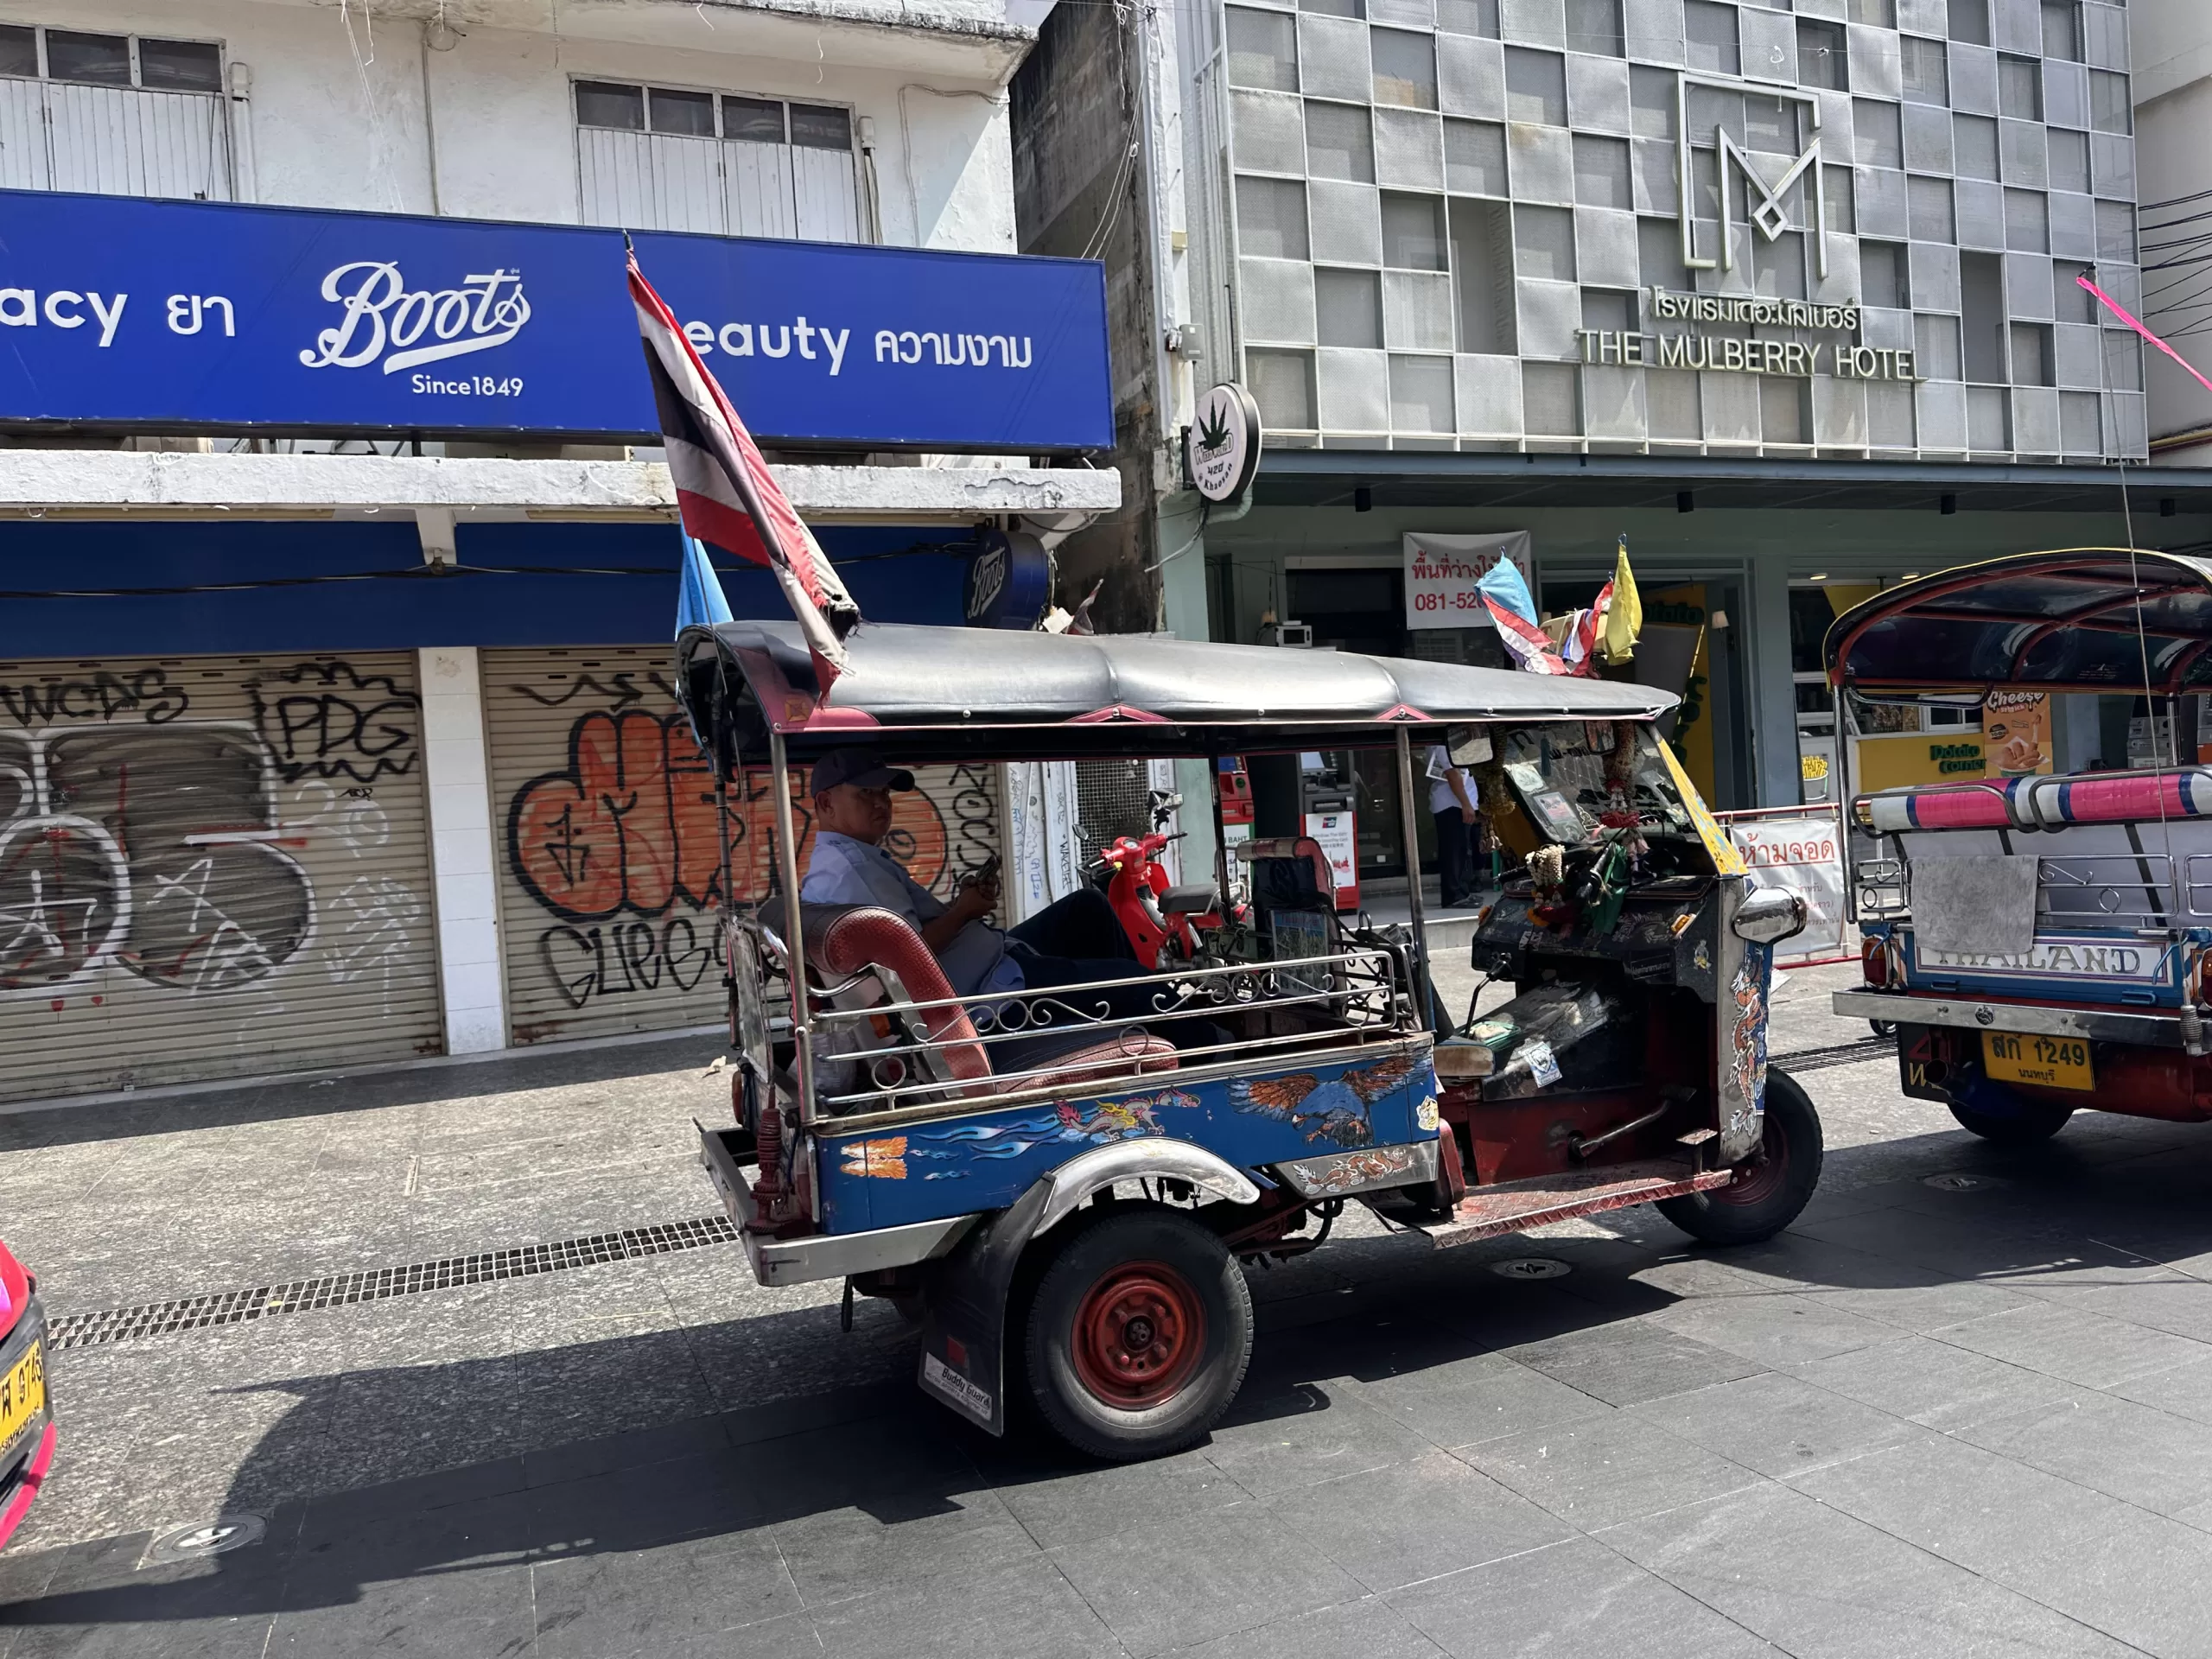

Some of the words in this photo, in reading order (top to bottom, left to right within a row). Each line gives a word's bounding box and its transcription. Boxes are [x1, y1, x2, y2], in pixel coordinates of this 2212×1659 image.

[167, 295, 236, 338] ยา
[299, 261, 532, 374] Boots
[679, 315, 850, 377] eauty
[874, 328, 1033, 369] ความงาม
[1574, 328, 1644, 366] THE
[1658, 334, 1823, 375] MULBERRY
[1831, 344, 1928, 383] HOTEL
[1204, 463, 1233, 491] Khaosan
[1207, 461, 1224, 476] 420
[968, 546, 1006, 620] Boots
[1738, 832, 1834, 865] ห้ามจอด
[2034, 1042, 2085, 1067] 1249
[2018, 1068, 2056, 1085] นนทบุรี
[942, 1367, 966, 1392] Buddy
[966, 1384, 991, 1408] Guard
